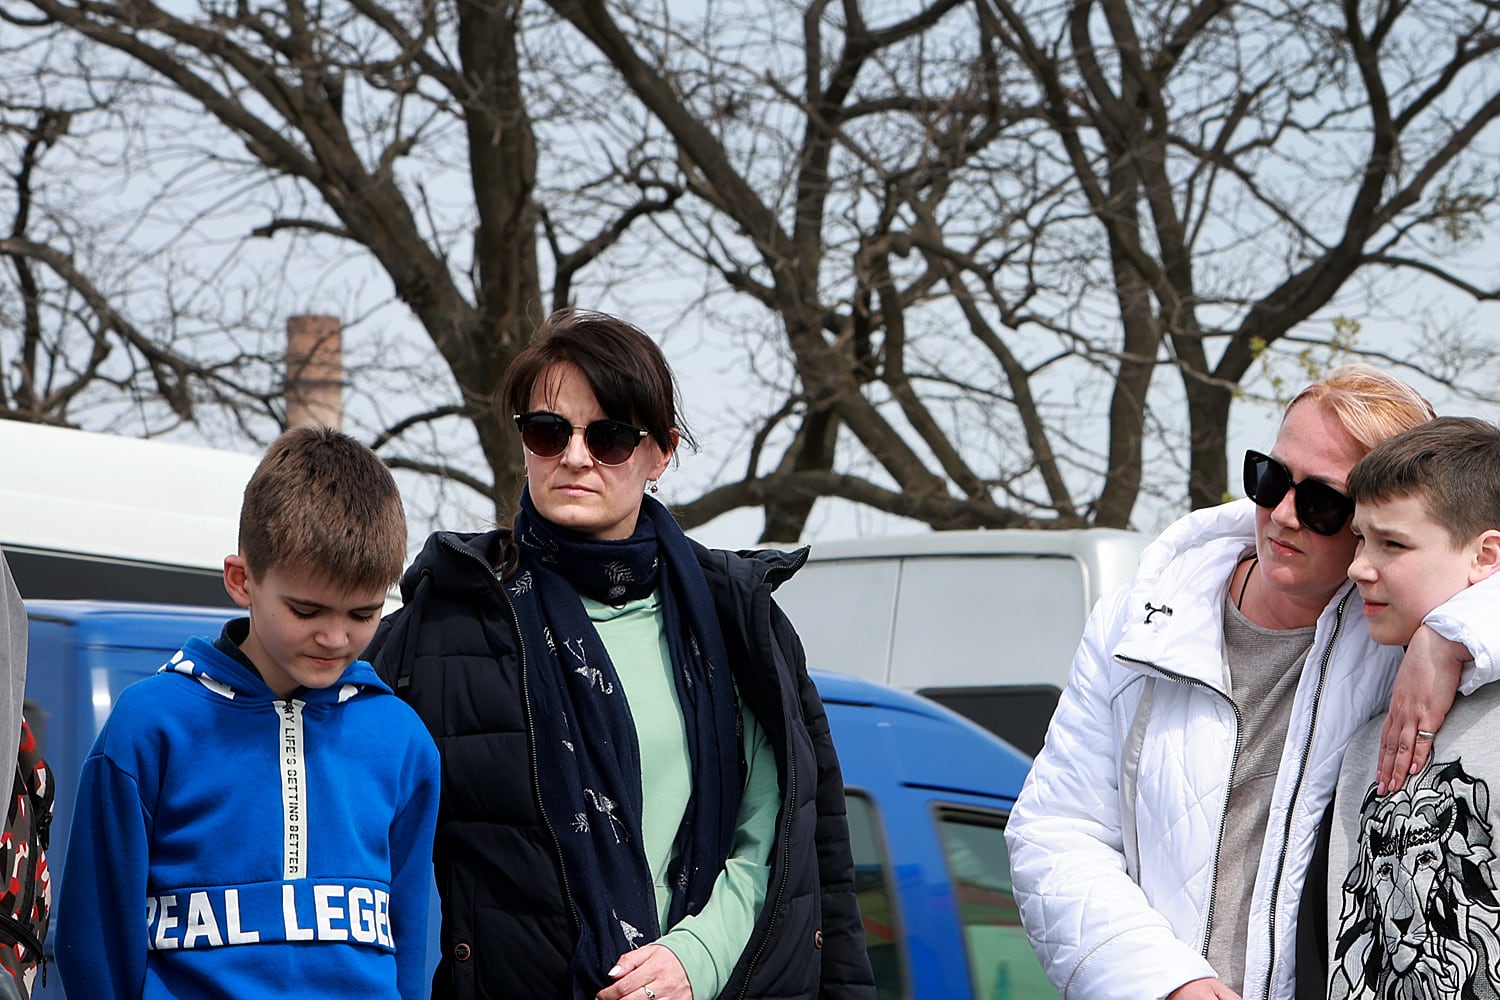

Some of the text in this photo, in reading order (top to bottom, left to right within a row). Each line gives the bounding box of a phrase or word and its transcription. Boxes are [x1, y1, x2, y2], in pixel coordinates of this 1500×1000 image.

[285, 727, 296, 765] LIFE'S
[287, 769, 299, 821] GETTING
[289, 825, 299, 874] BETTER
